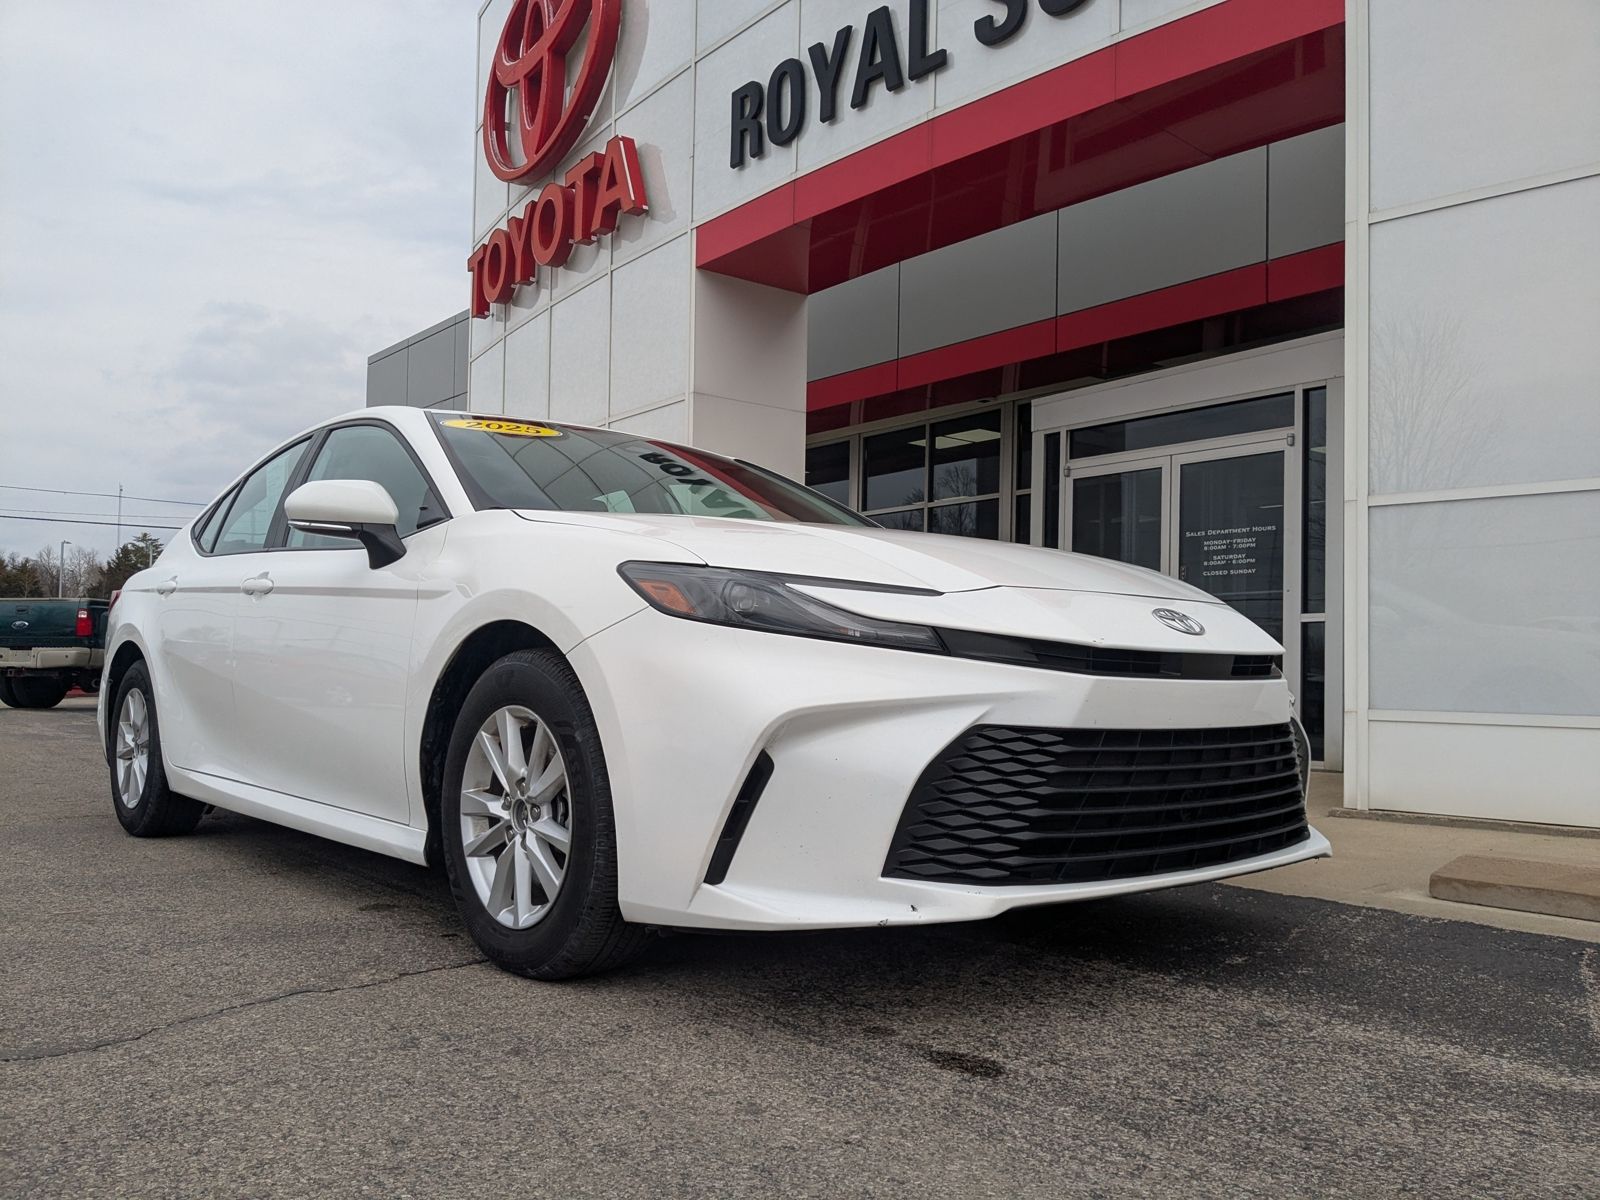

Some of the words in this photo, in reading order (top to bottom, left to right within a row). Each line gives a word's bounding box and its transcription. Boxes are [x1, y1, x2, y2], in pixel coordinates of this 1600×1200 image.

[730, 0, 947, 169] ROYAL
[467, 135, 648, 319] TOYOTA
[466, 421, 541, 434] 2025
